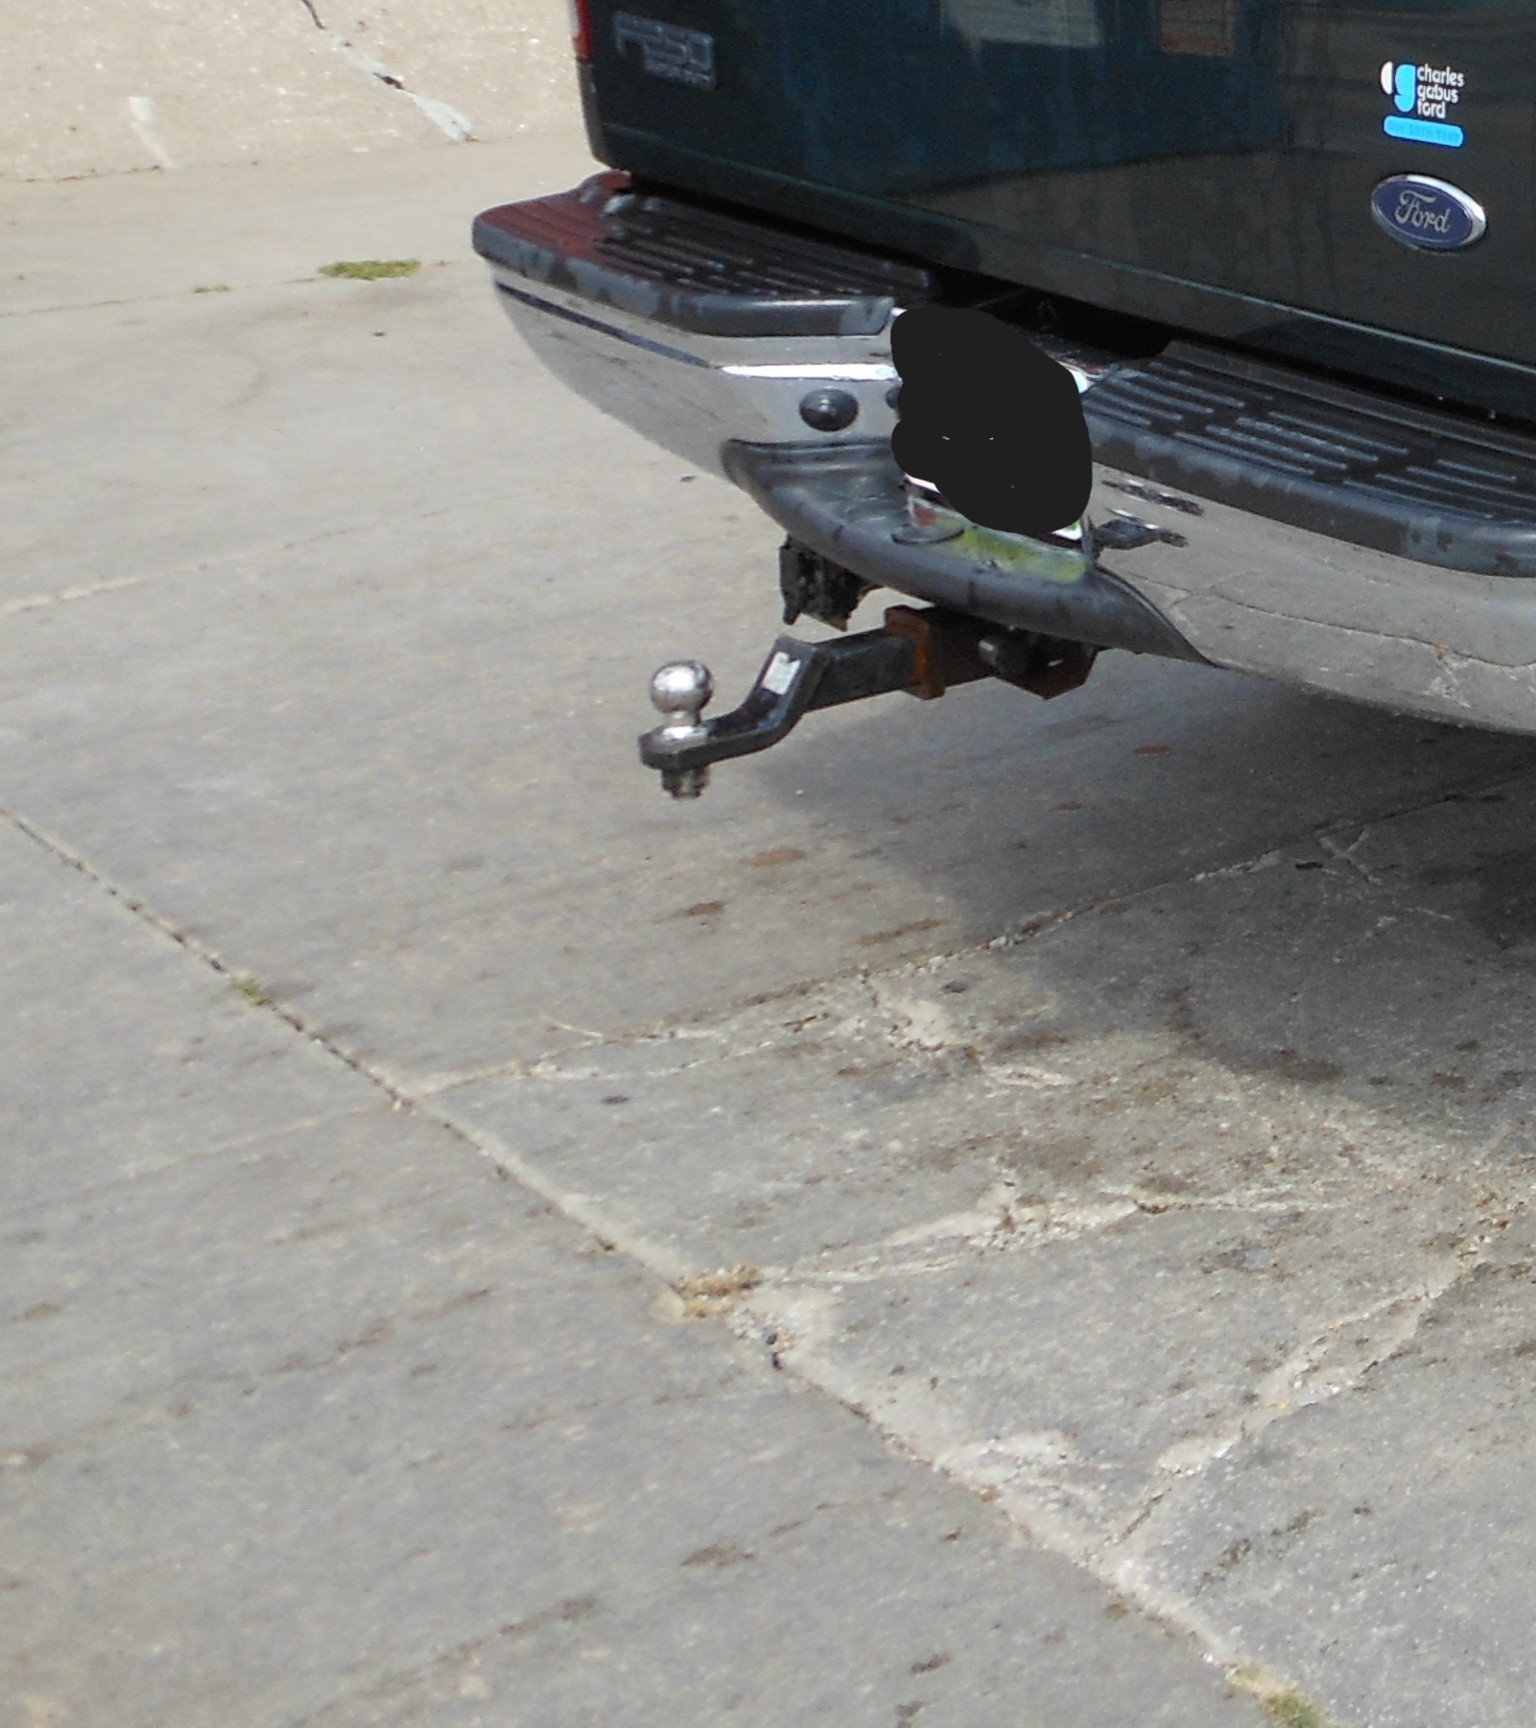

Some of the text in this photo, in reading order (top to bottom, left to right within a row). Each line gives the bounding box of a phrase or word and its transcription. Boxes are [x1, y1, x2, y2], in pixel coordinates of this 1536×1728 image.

[1417, 63, 1465, 88] charles
[1417, 83, 1459, 104] gabus
[1417, 100, 1447, 120] ford
[1395, 189, 1452, 234] Ford
